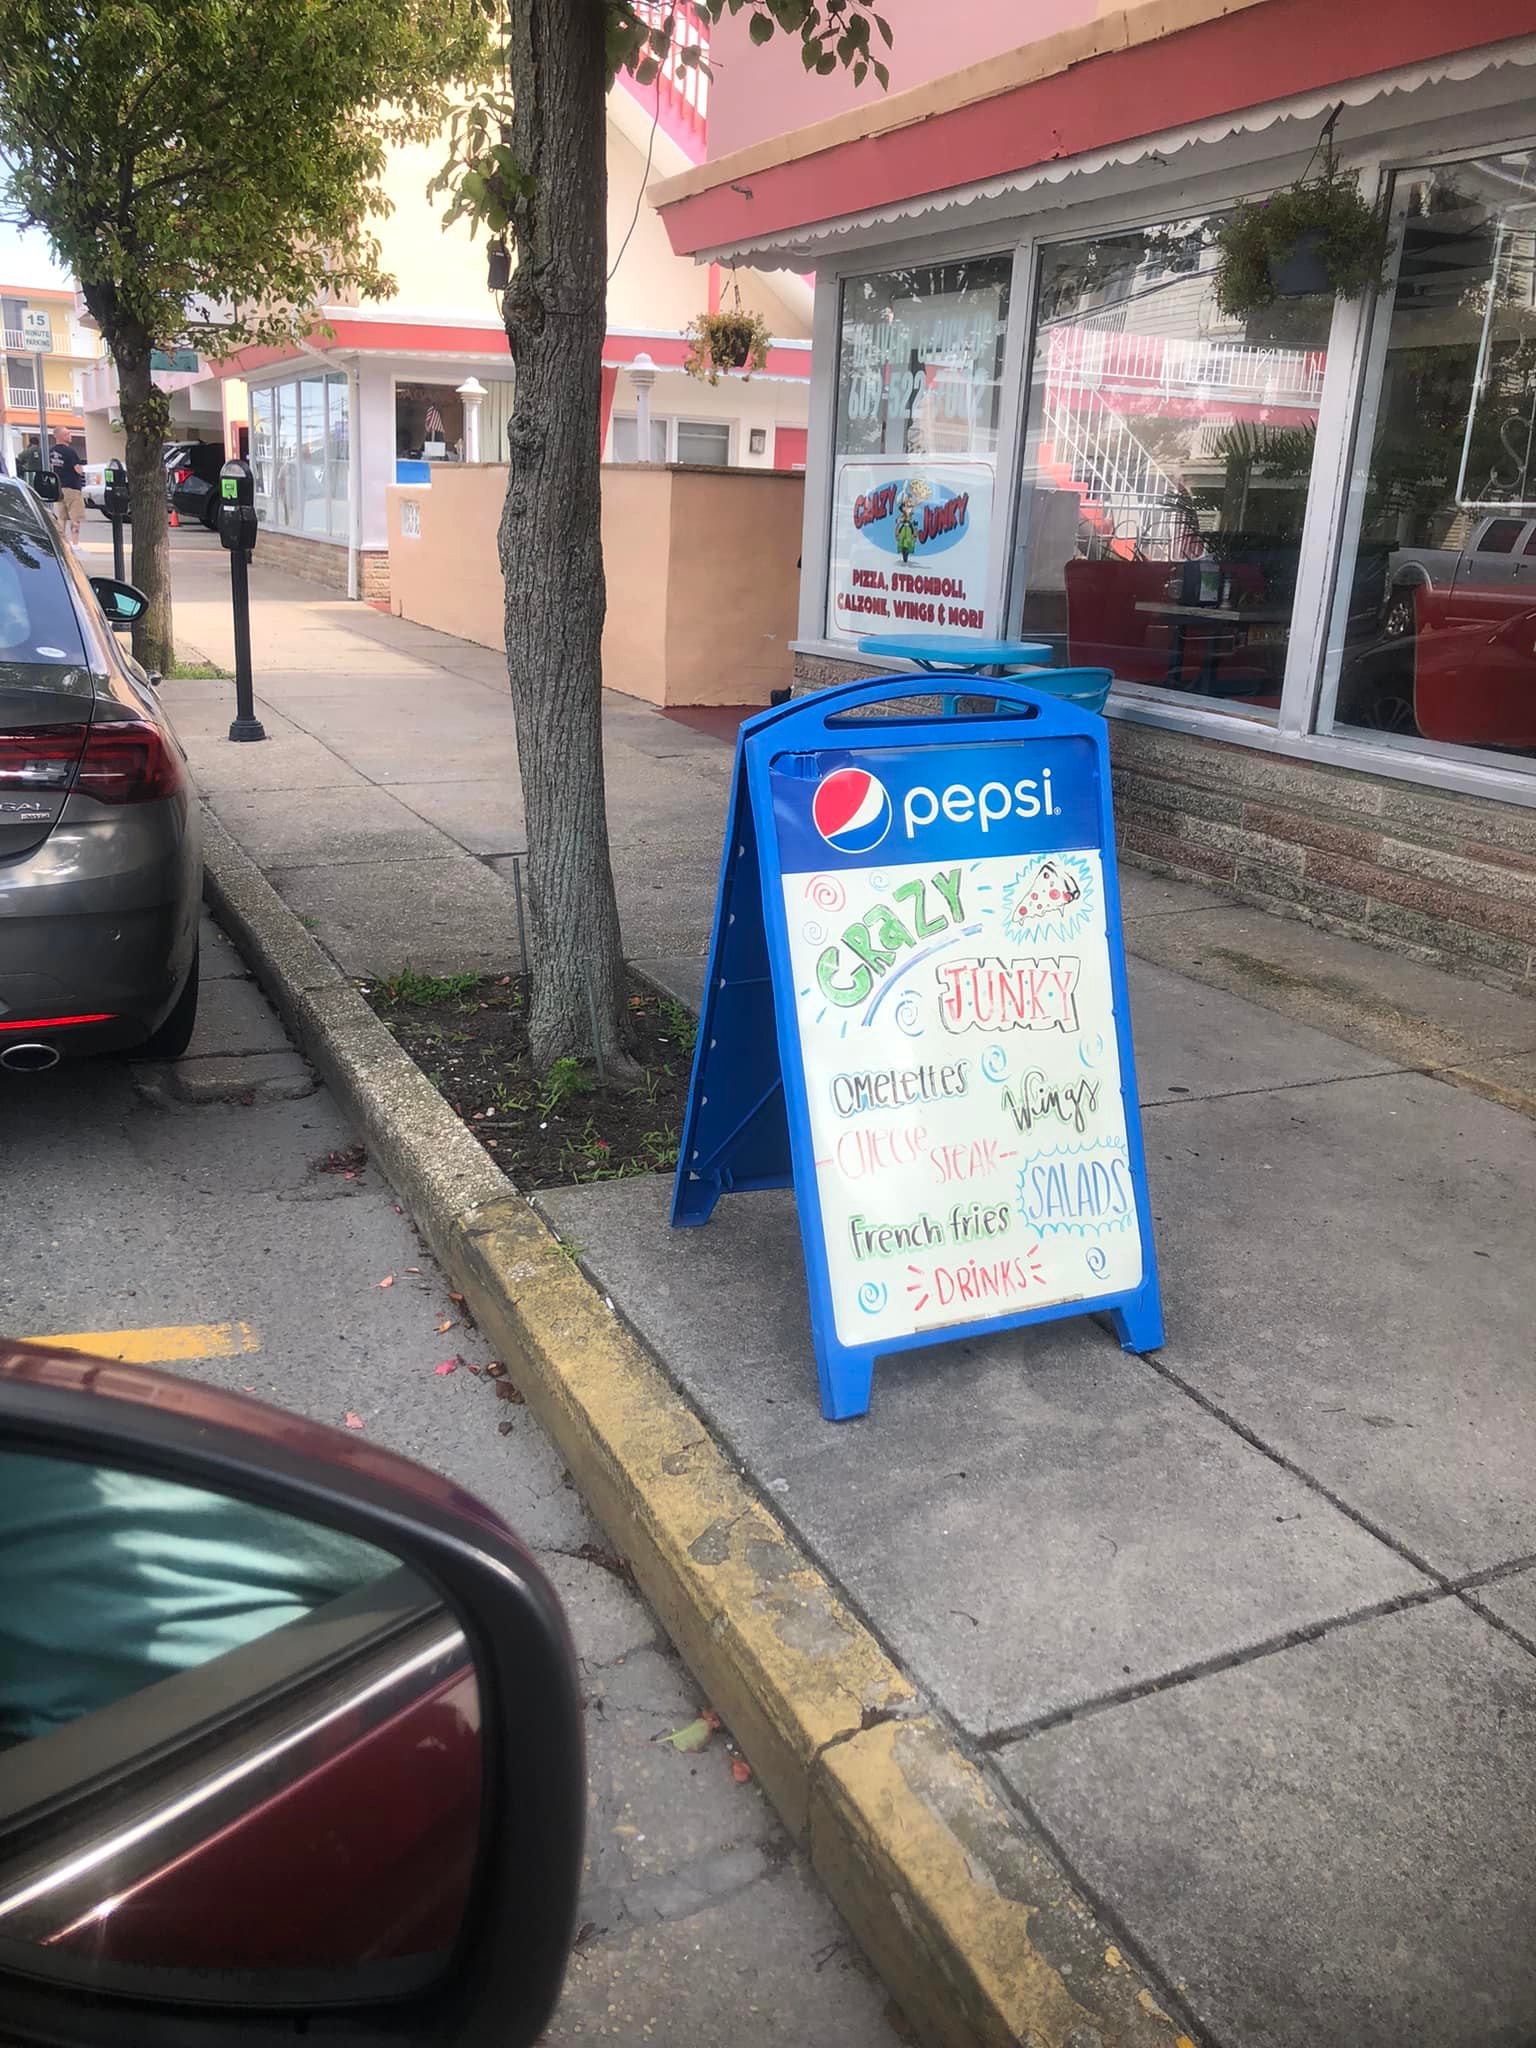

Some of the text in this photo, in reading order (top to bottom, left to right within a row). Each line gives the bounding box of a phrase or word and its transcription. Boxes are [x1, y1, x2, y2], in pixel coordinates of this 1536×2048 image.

[27, 314, 46, 326] 15
[853, 484, 969, 544] CRAZY JUNKY
[852, 569, 967, 600] PIZZA, STROMBOLI,
[893, 599, 935, 623] WINGS
[941, 961, 1076, 1027] JUNKY
[1003, 1070, 1100, 1133] Wings
[1028, 1158, 1128, 1220] SALADS
[850, 1205, 1009, 1259] French fries
